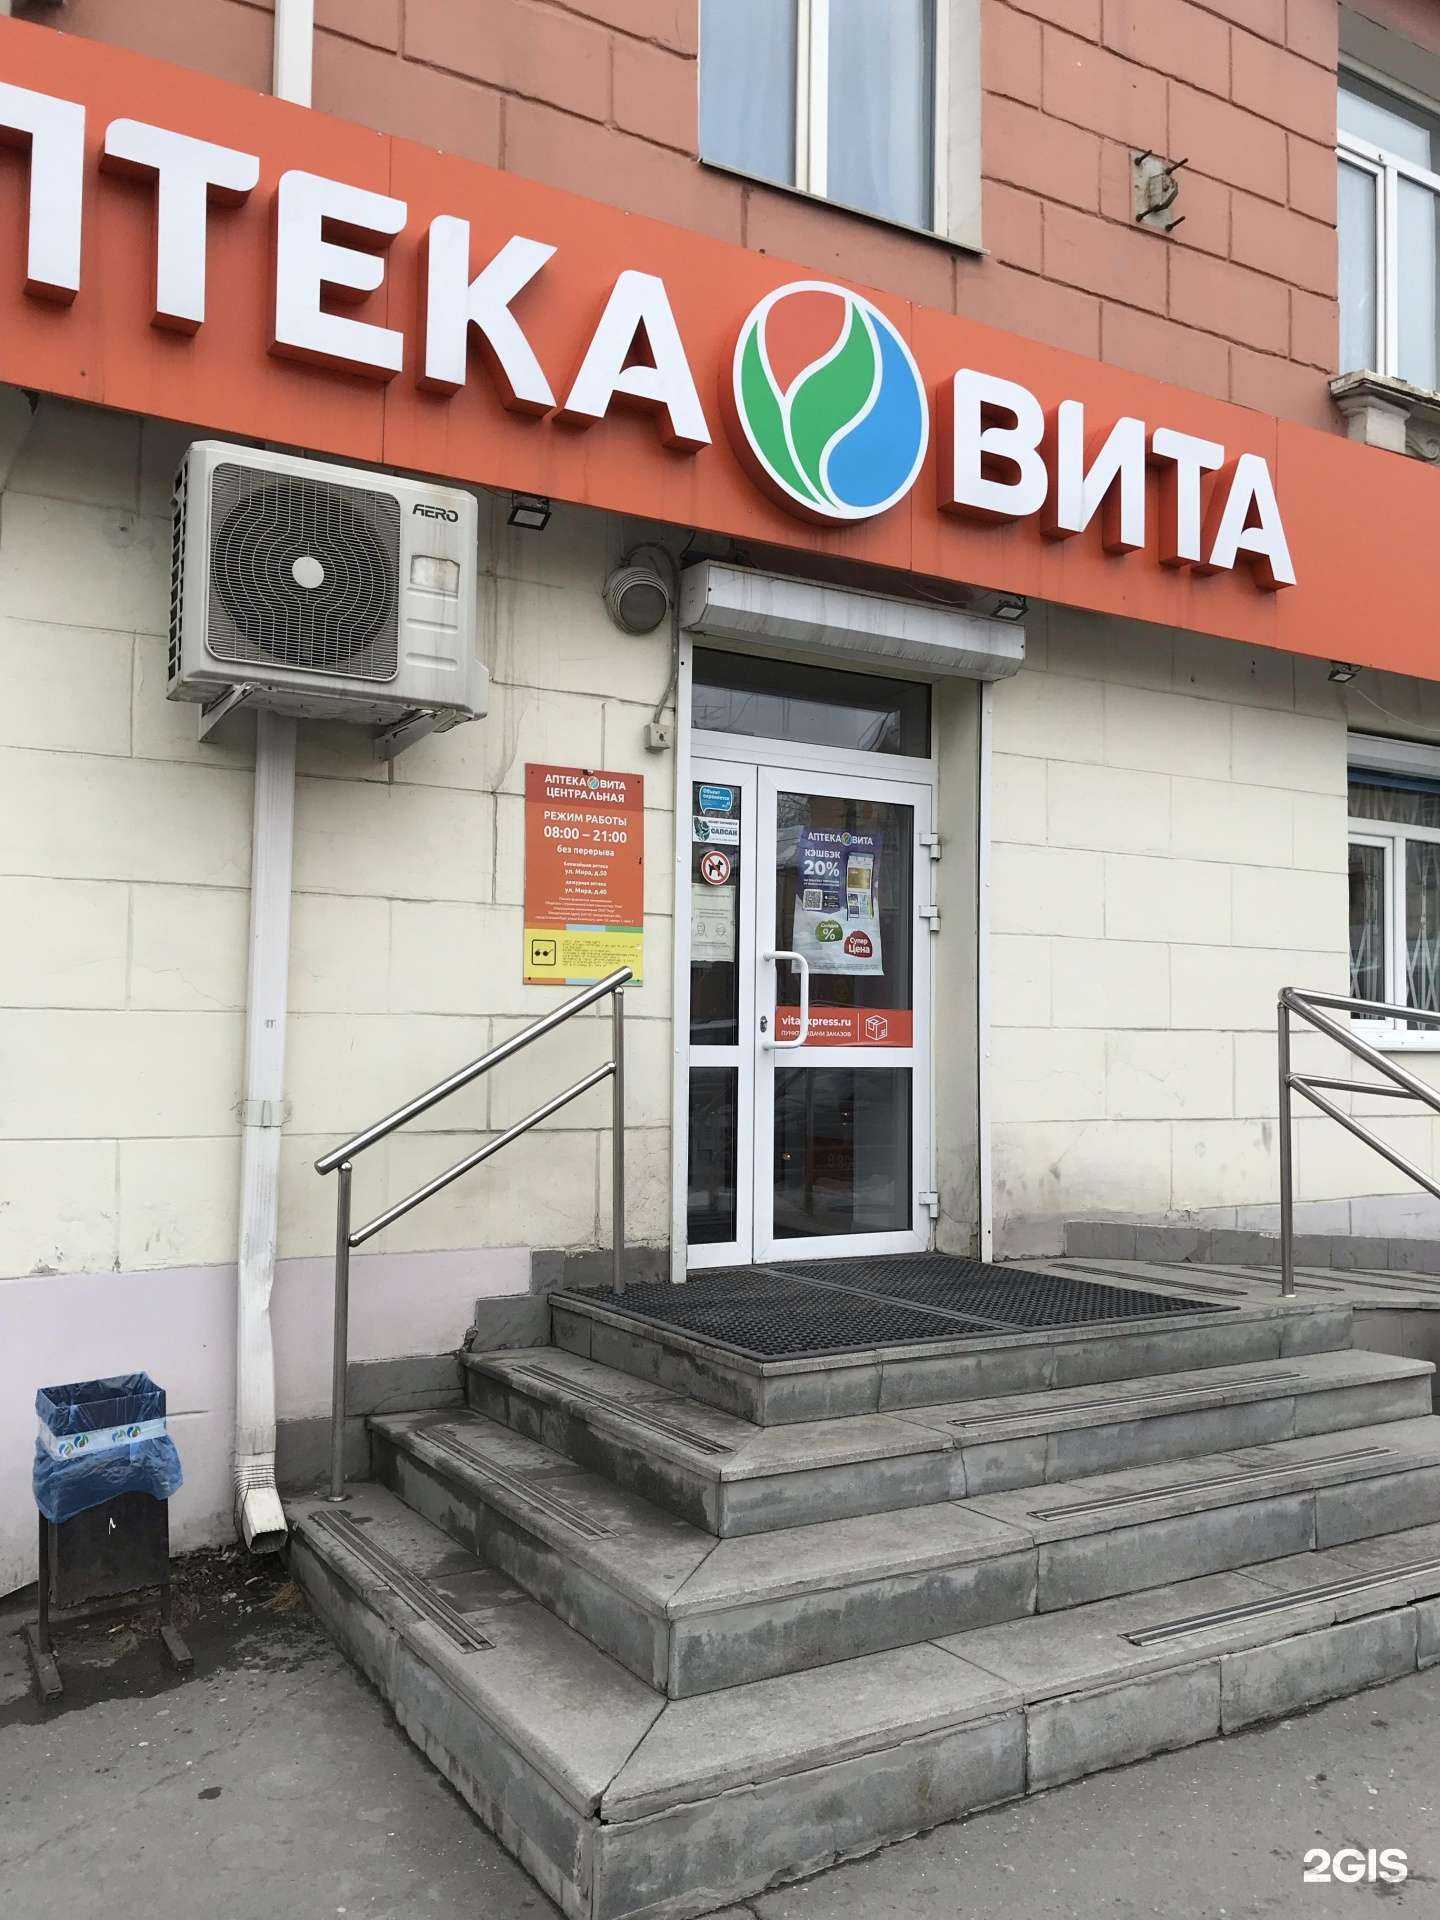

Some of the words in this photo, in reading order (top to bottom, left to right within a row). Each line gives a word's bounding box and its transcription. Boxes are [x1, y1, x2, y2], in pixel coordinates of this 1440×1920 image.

[953, 367, 1297, 585] ВИТА
[412, 503, 459, 523] AERO
[544, 774, 587, 787] АПТЕКА
[600, 779, 626, 791] ВИТА
[546, 787, 625, 803] ЦЕНТРАЛЬНАЯ
[544, 810, 583, 823] РЕЖИМ
[585, 814, 627, 827] РАБОТЫ
[543, 825, 580, 840] 08:00
[592, 829, 627, 844] 21:00
[808, 832, 842, 842] АПТЕКА
[851, 835, 874, 846] ВИТА
[556, 844, 571, 854] без
[573, 847, 615, 857] перерыва
[804, 848, 840, 859] КЭШБЭК
[803, 860, 840, 877] 20%
[849, 937, 868, 945] Супер
[848, 944, 870, 955] Цена
[781, 1015, 852, 1027] vitaxpress.ru
